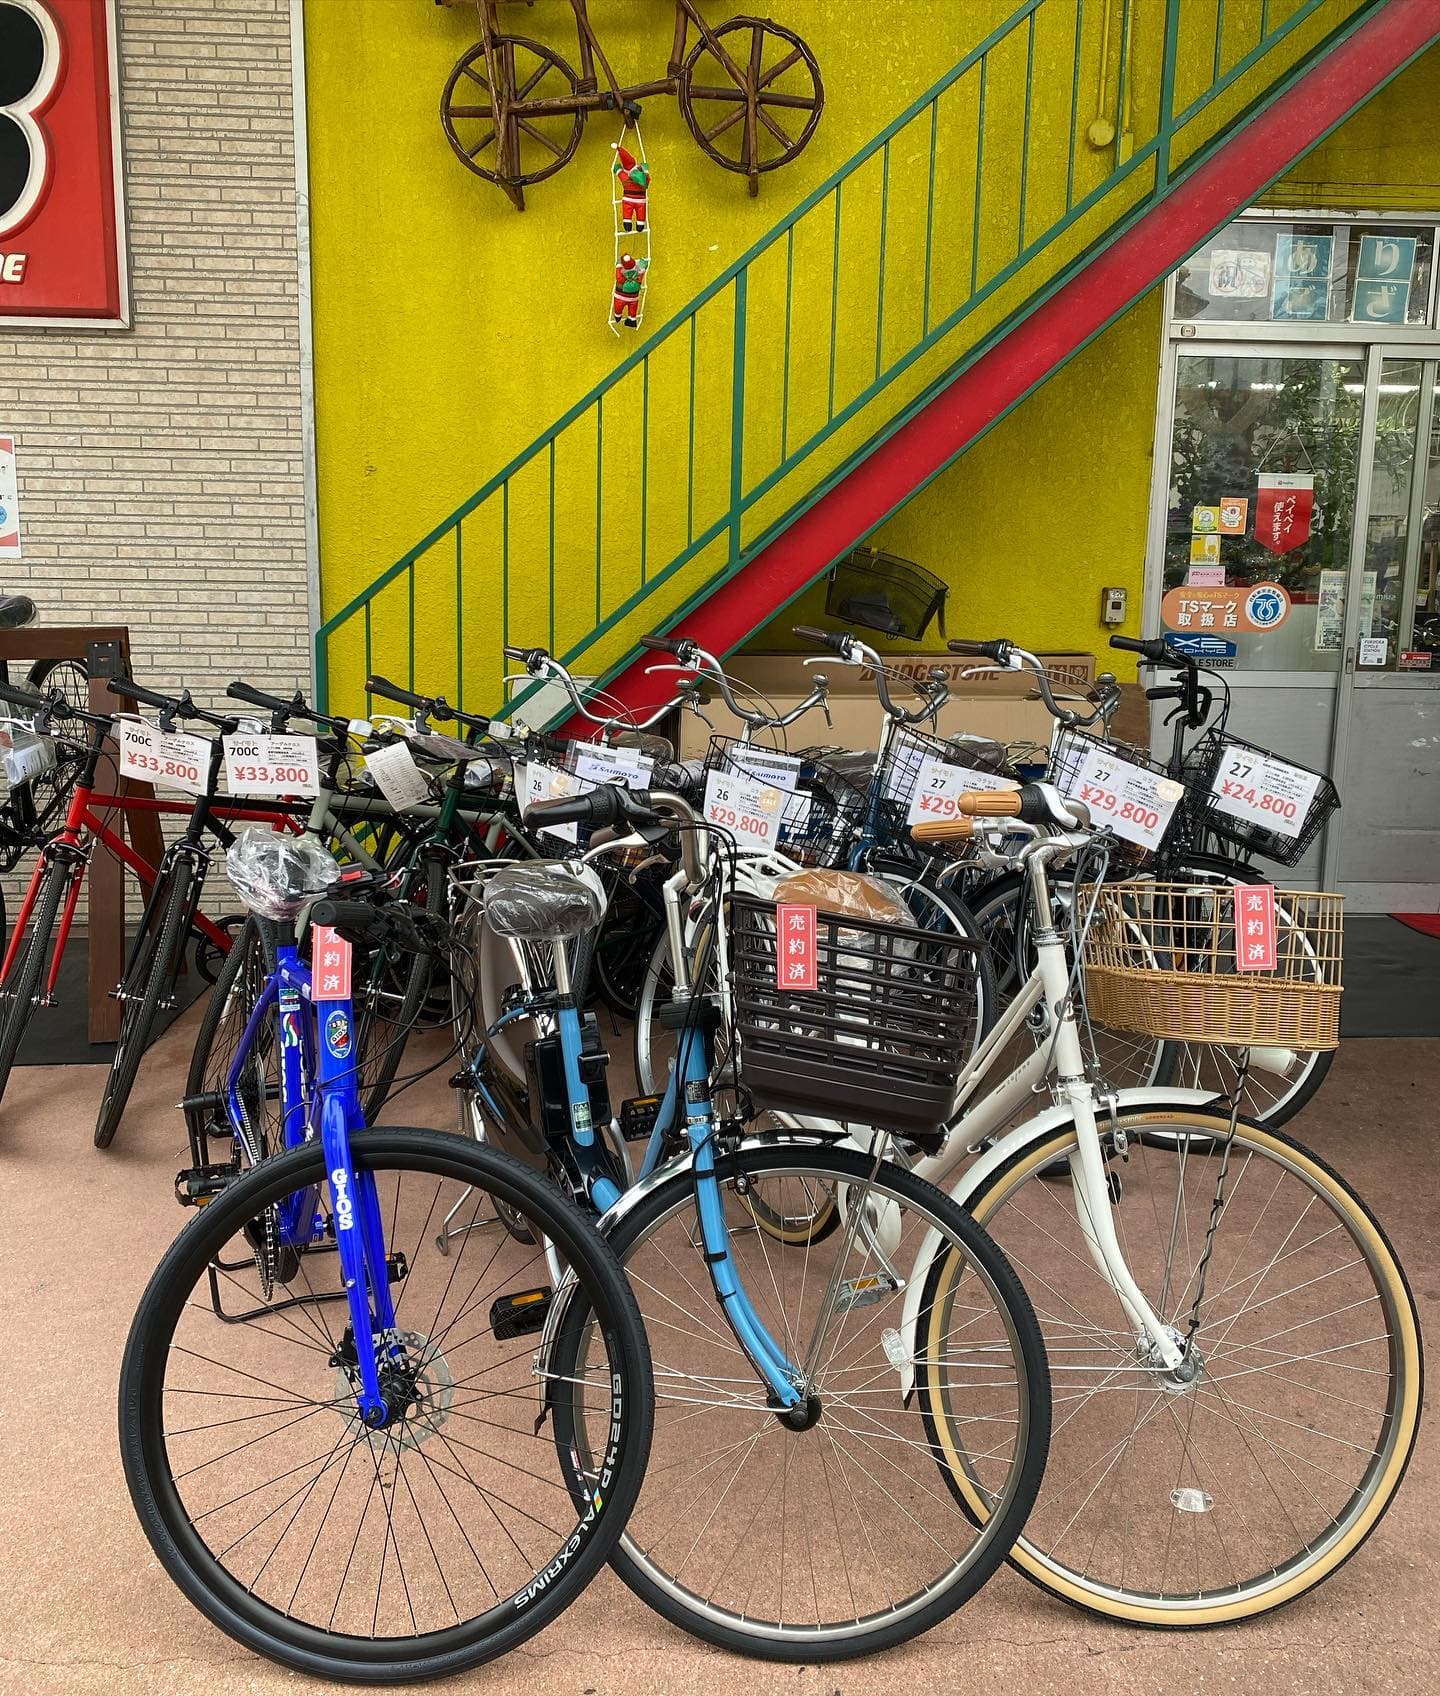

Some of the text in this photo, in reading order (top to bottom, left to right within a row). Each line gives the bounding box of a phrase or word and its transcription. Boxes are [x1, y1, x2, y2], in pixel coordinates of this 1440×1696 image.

[1272, 501, 1285, 545] 使えます。
[1283, 495, 1296, 533] ペイペイ
[1177, 612, 1239, 627] 取扱店
[1178, 600, 1238, 613] TSマーク
[1206, 659, 1234, 668] STORE
[125, 731, 152, 747] 700C
[229, 746, 259, 756] 700C
[127, 751, 199, 781] ¥33,800
[234, 766, 309, 784] ¥33,800
[1094, 769, 1111, 782] 27
[1229, 762, 1252, 778] 27
[533, 780, 542, 791] 26
[716, 788, 729, 801] 26
[931, 778, 946, 790] 27
[1221, 779, 1297, 819] ¥24,800
[709, 804, 769, 838] ¥29,800
[1080, 783, 1159, 829] ¥29,800
[1247, 894, 1265, 961] 売約済
[323, 927, 341, 991] 売約済
[788, 913, 806, 980] 売約済
[331, 1168, 354, 1231] GIOS
[602, 1373, 622, 1489] GD24P
[514, 1503, 596, 1609] ALEXRIMS
